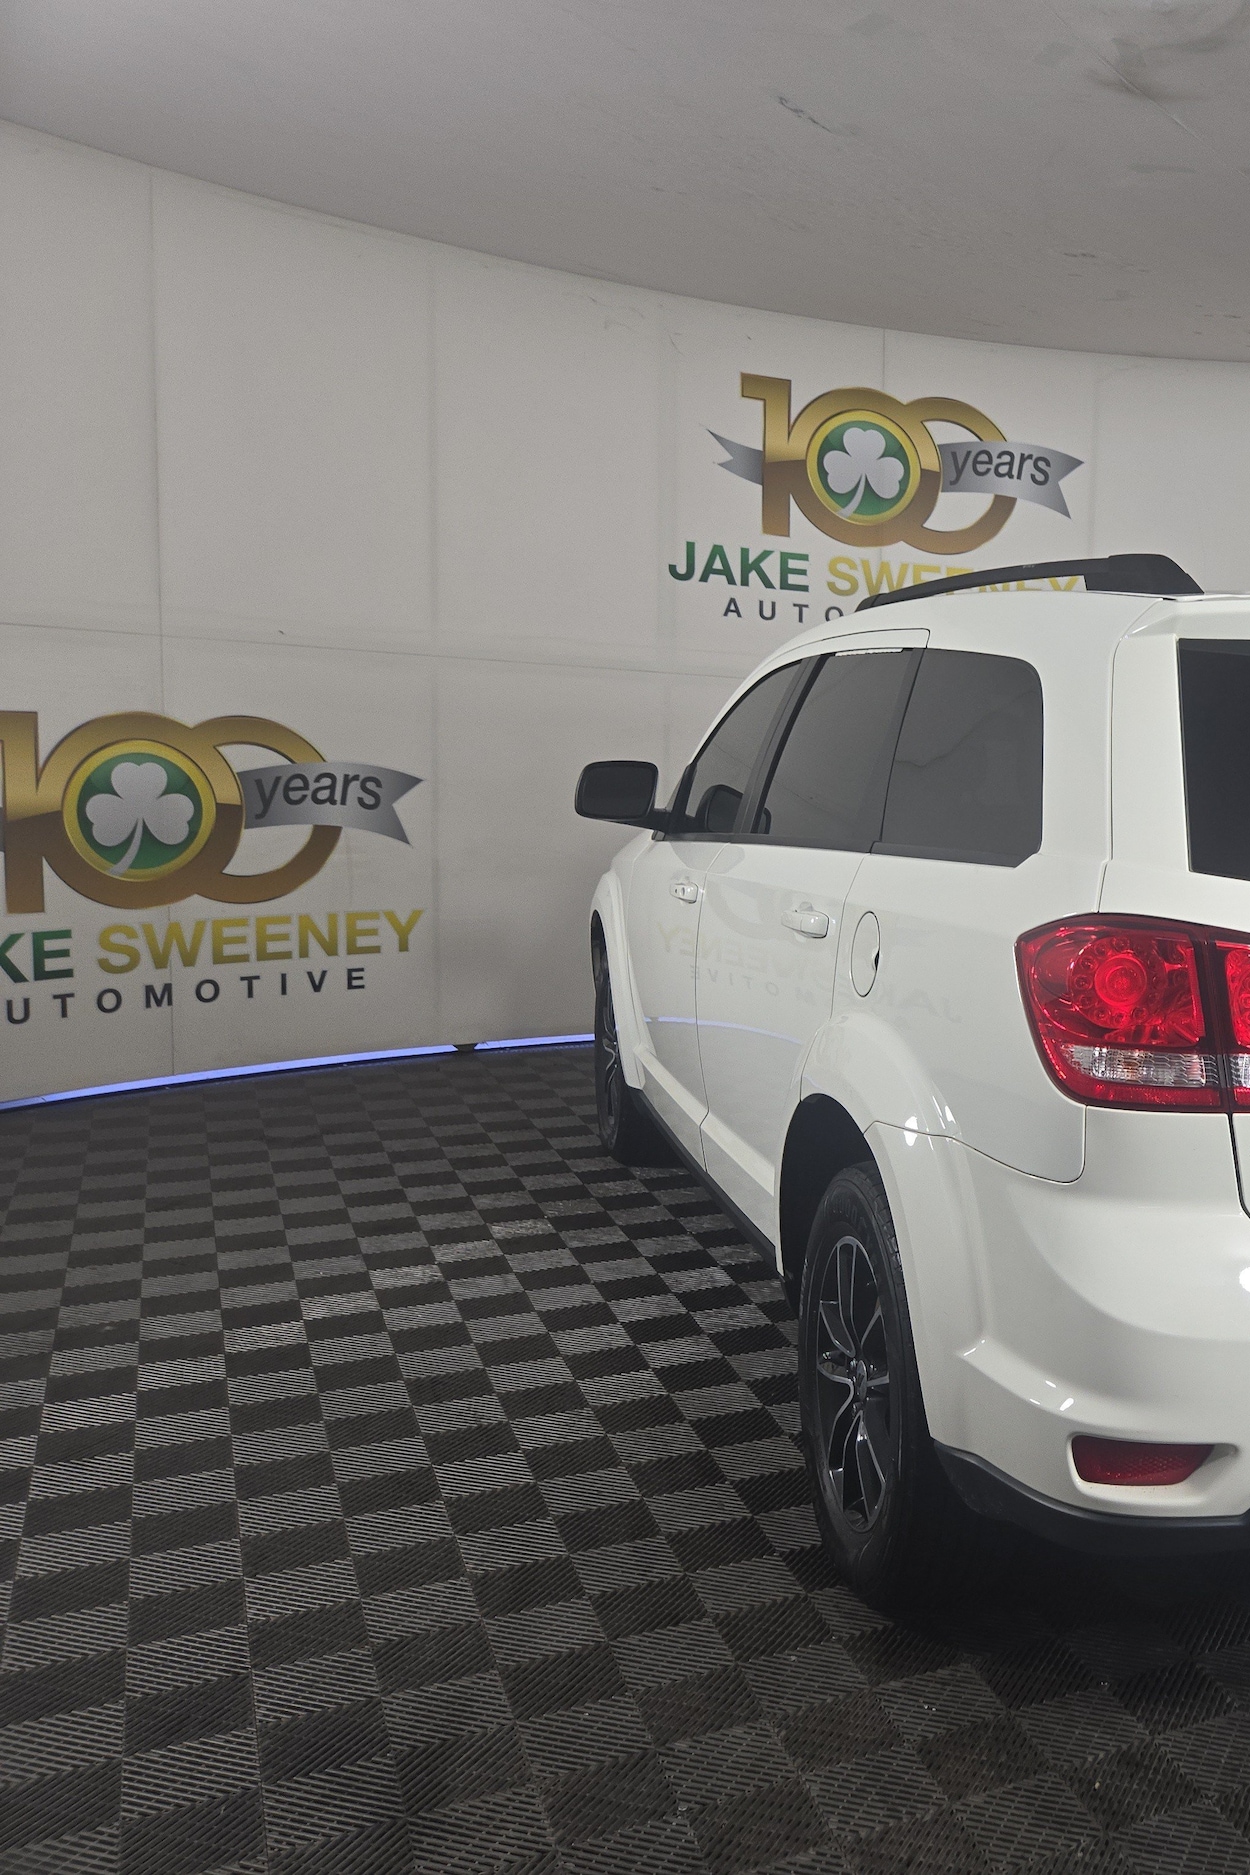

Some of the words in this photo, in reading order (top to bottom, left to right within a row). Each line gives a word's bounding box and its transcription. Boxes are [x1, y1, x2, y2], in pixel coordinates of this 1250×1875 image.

[949, 449, 1052, 486] years
[668, 540, 811, 593] JAKE
[254, 772, 383, 820] years
[97, 909, 425, 975] SWEENEY
[5, 966, 367, 1025] UTOMOTIVE
